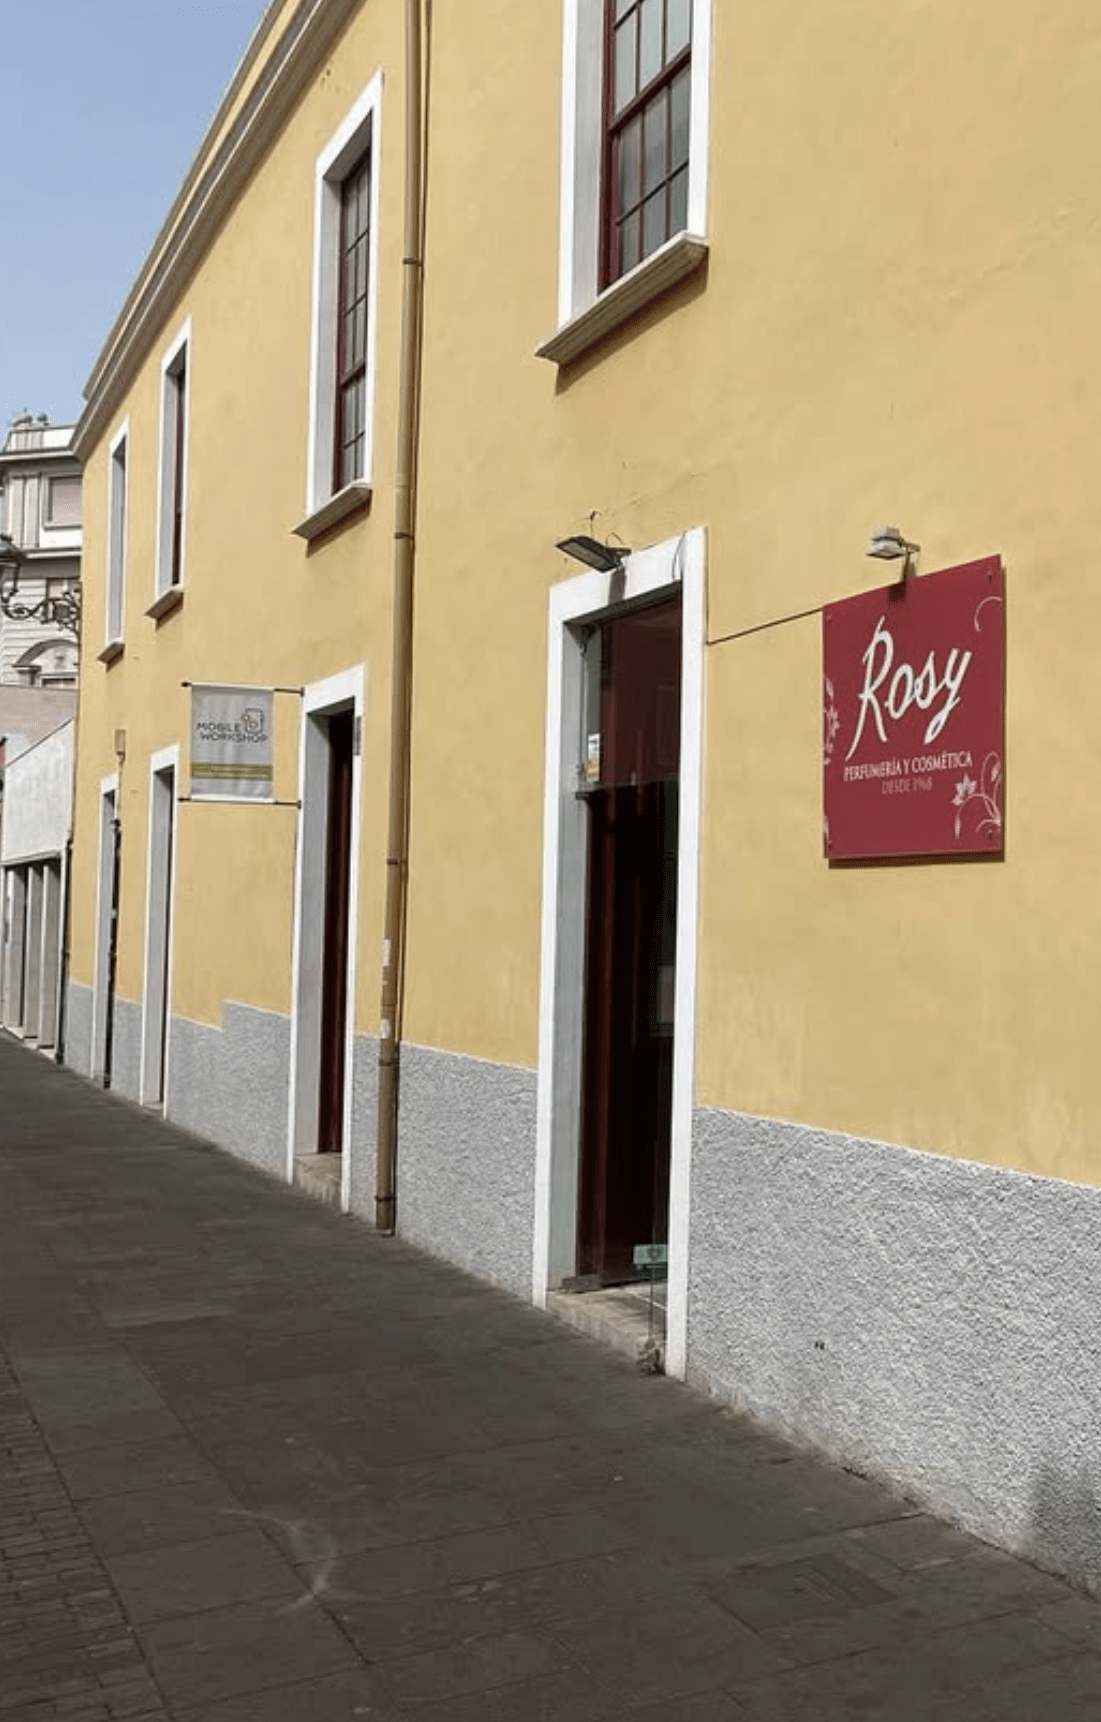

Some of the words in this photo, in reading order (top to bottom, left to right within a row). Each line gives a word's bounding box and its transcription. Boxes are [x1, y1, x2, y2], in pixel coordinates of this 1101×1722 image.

[845, 614, 973, 762] Rosy
[196, 722, 241, 733] MOBILE
[200, 731, 269, 744] WORKSHOP
[843, 756, 902, 782] PERFUMERÍA
[903, 759, 911, 775] Y
[911, 750, 973, 774] COSMÉTICA
